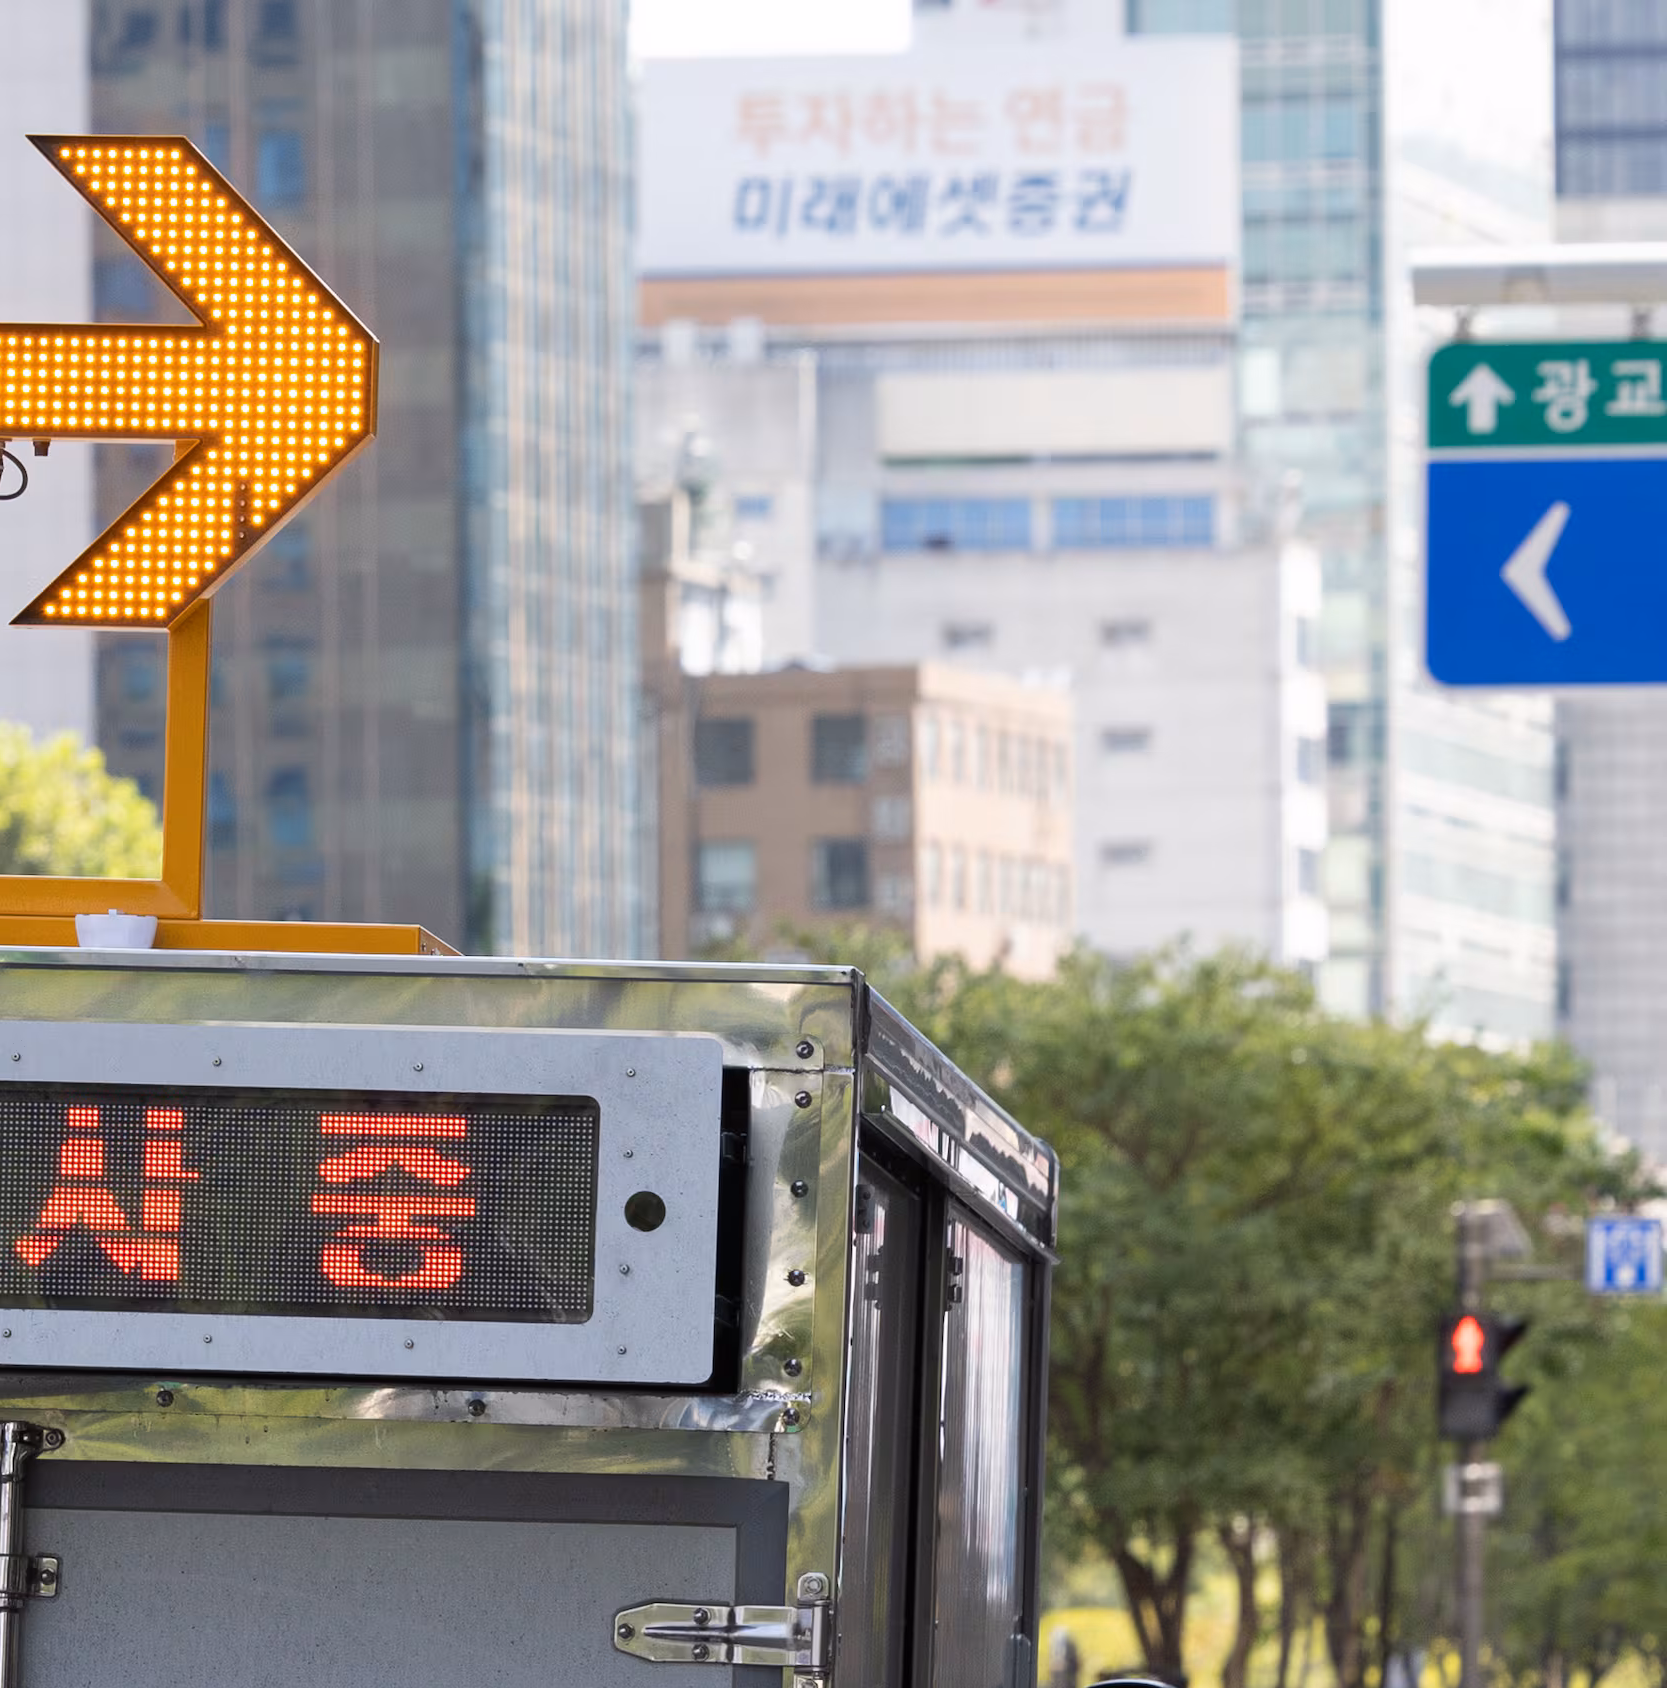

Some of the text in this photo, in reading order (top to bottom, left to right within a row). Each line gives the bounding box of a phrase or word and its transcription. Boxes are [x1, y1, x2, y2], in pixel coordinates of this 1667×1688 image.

[735, 83, 1130, 158] 투자하는 연금
[732, 165, 1135, 240] 미래에셋증권
[1530, 356, 1667, 435] 광교
